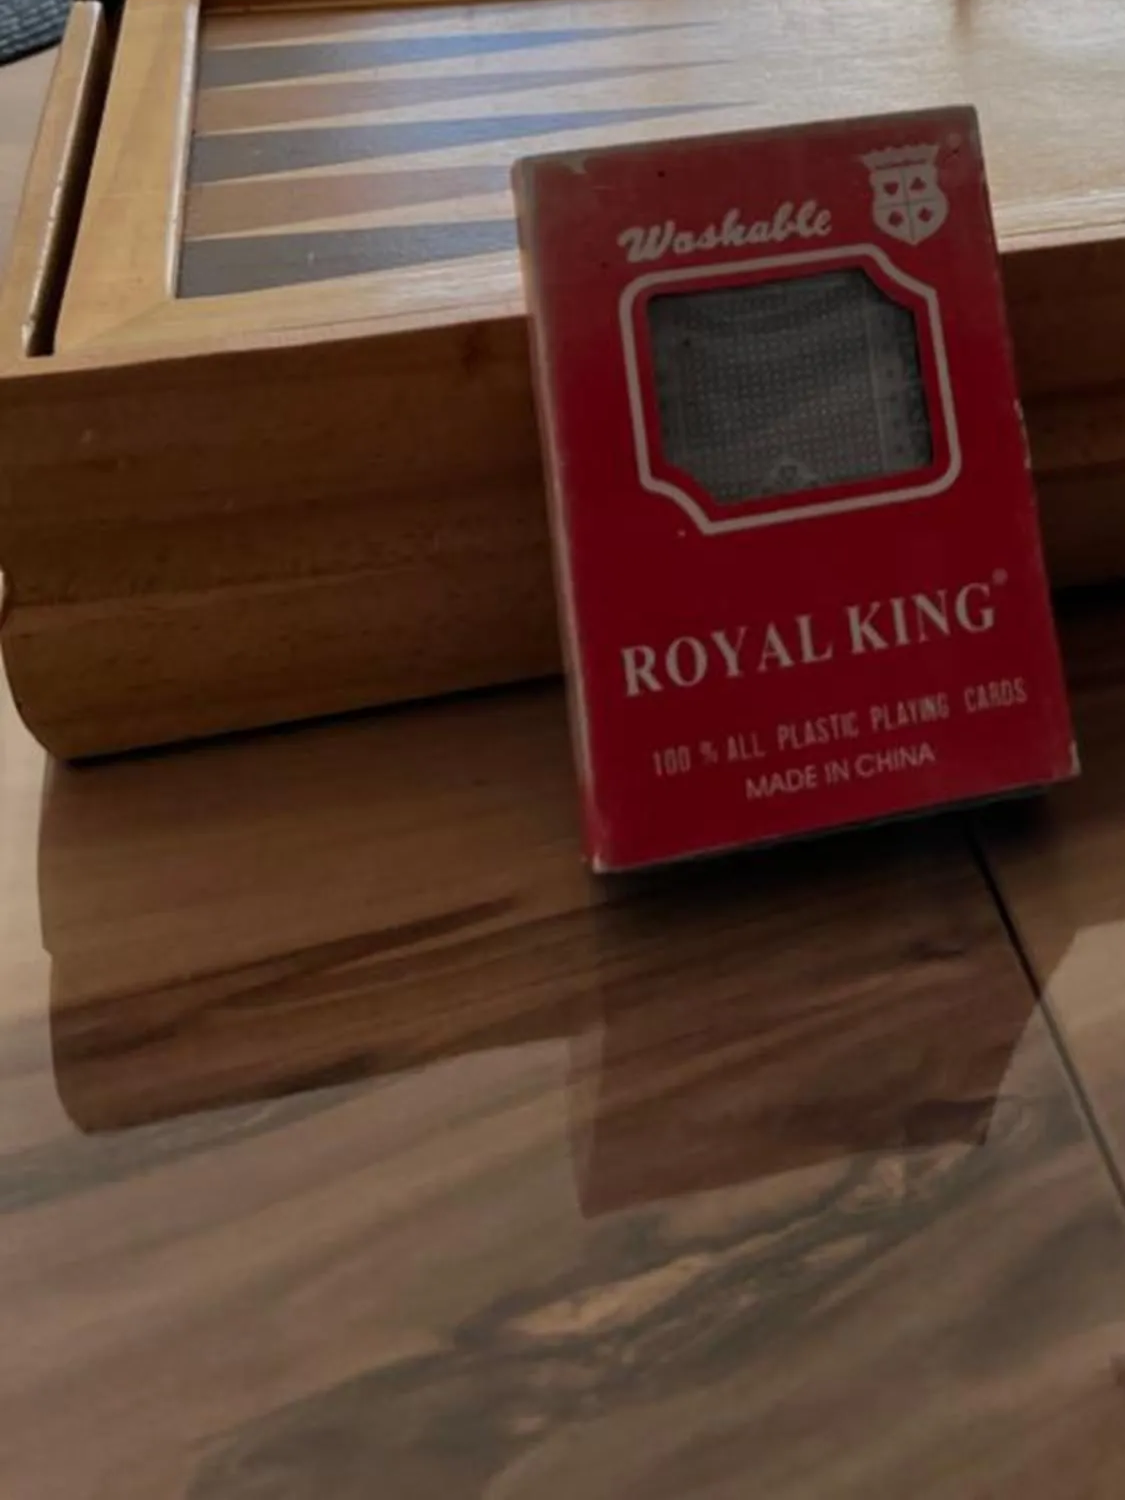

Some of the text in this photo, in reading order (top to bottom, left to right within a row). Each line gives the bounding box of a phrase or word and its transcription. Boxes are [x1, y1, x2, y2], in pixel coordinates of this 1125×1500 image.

[616, 199, 833, 264] Washable
[619, 613, 834, 698] ROYAL
[651, 740, 692, 778] 100
[726, 727, 766, 763] ALL
[775, 709, 860, 752] PLASTIC
[869, 691, 951, 732] PLAYING
[962, 675, 1029, 713] CARDS
[745, 741, 937, 801] MADE IN CHINA
